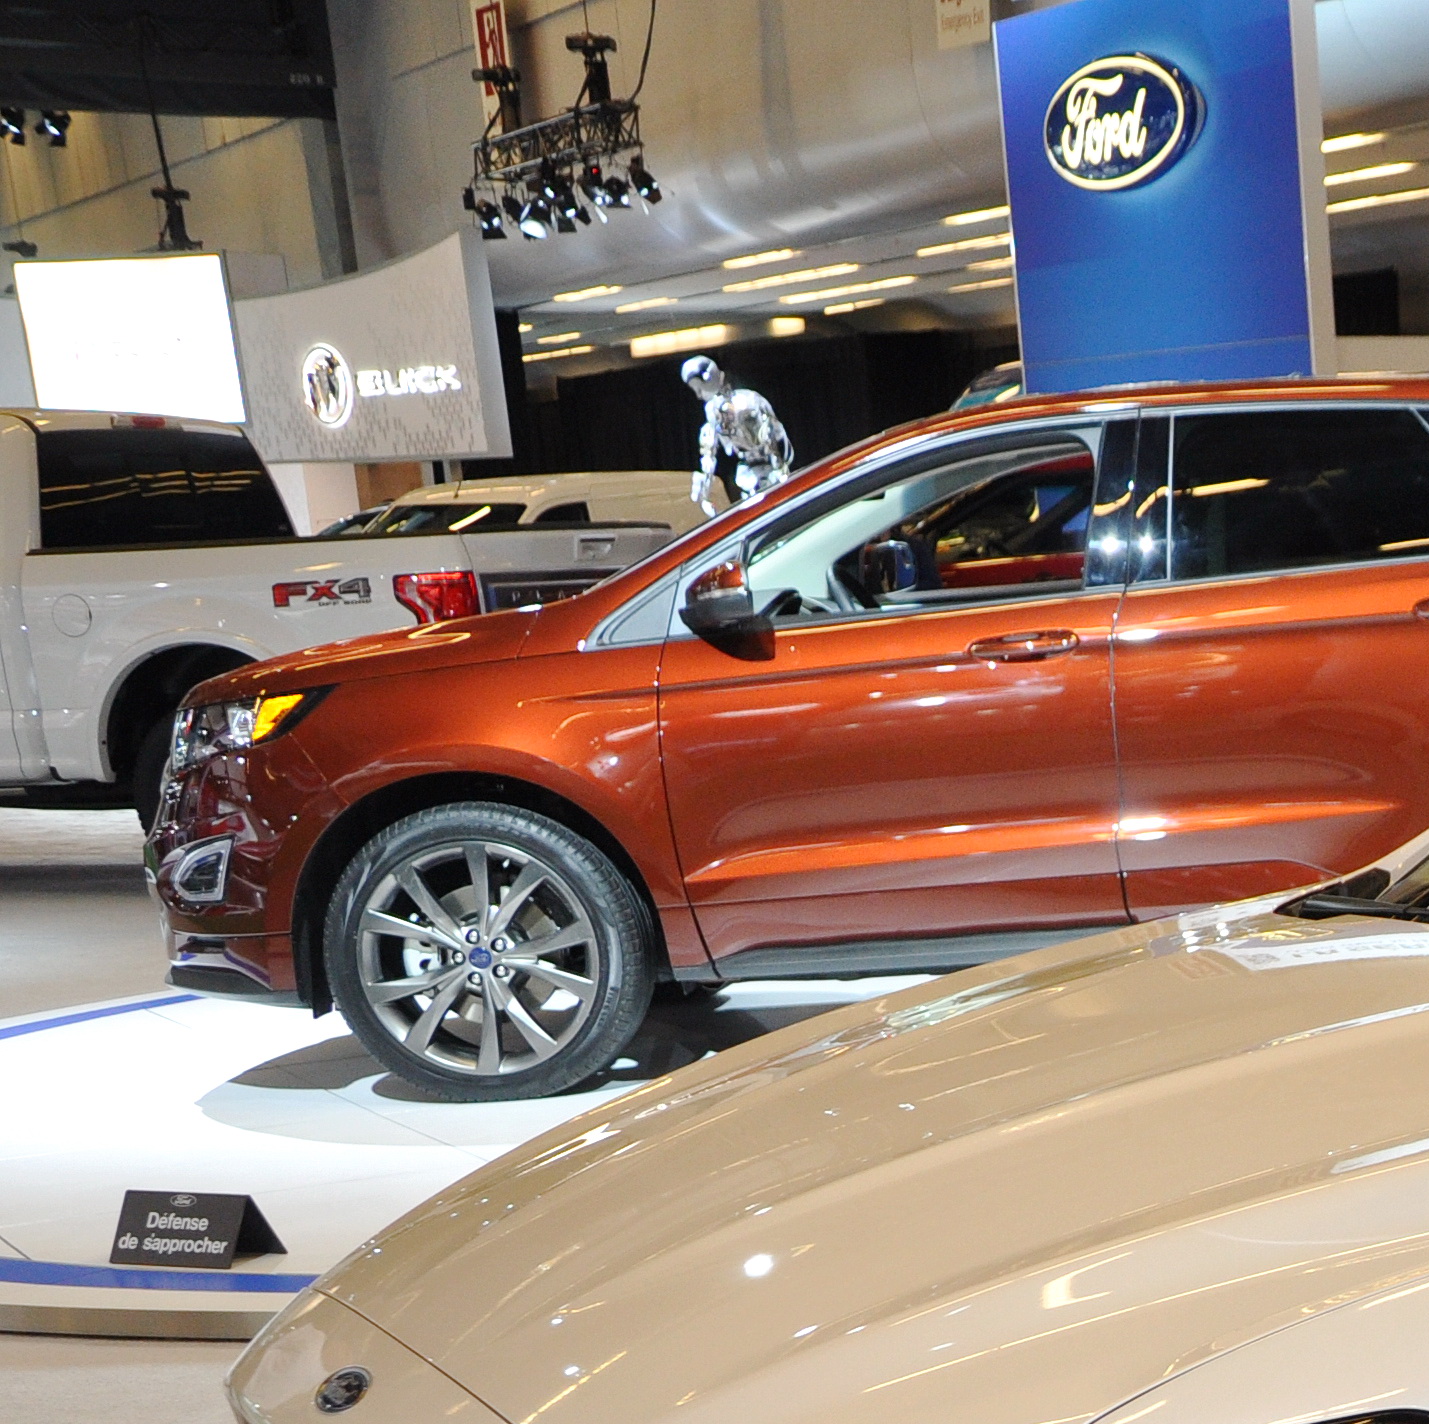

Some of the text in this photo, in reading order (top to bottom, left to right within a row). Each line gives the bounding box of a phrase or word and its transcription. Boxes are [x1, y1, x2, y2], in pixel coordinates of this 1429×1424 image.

[1061, 73, 1148, 170] Ford
[355, 364, 462, 397] BUICK
[272, 577, 372, 608] FX4
[146, 1211, 210, 1231] Défense
[118, 1232, 139, 1250] de
